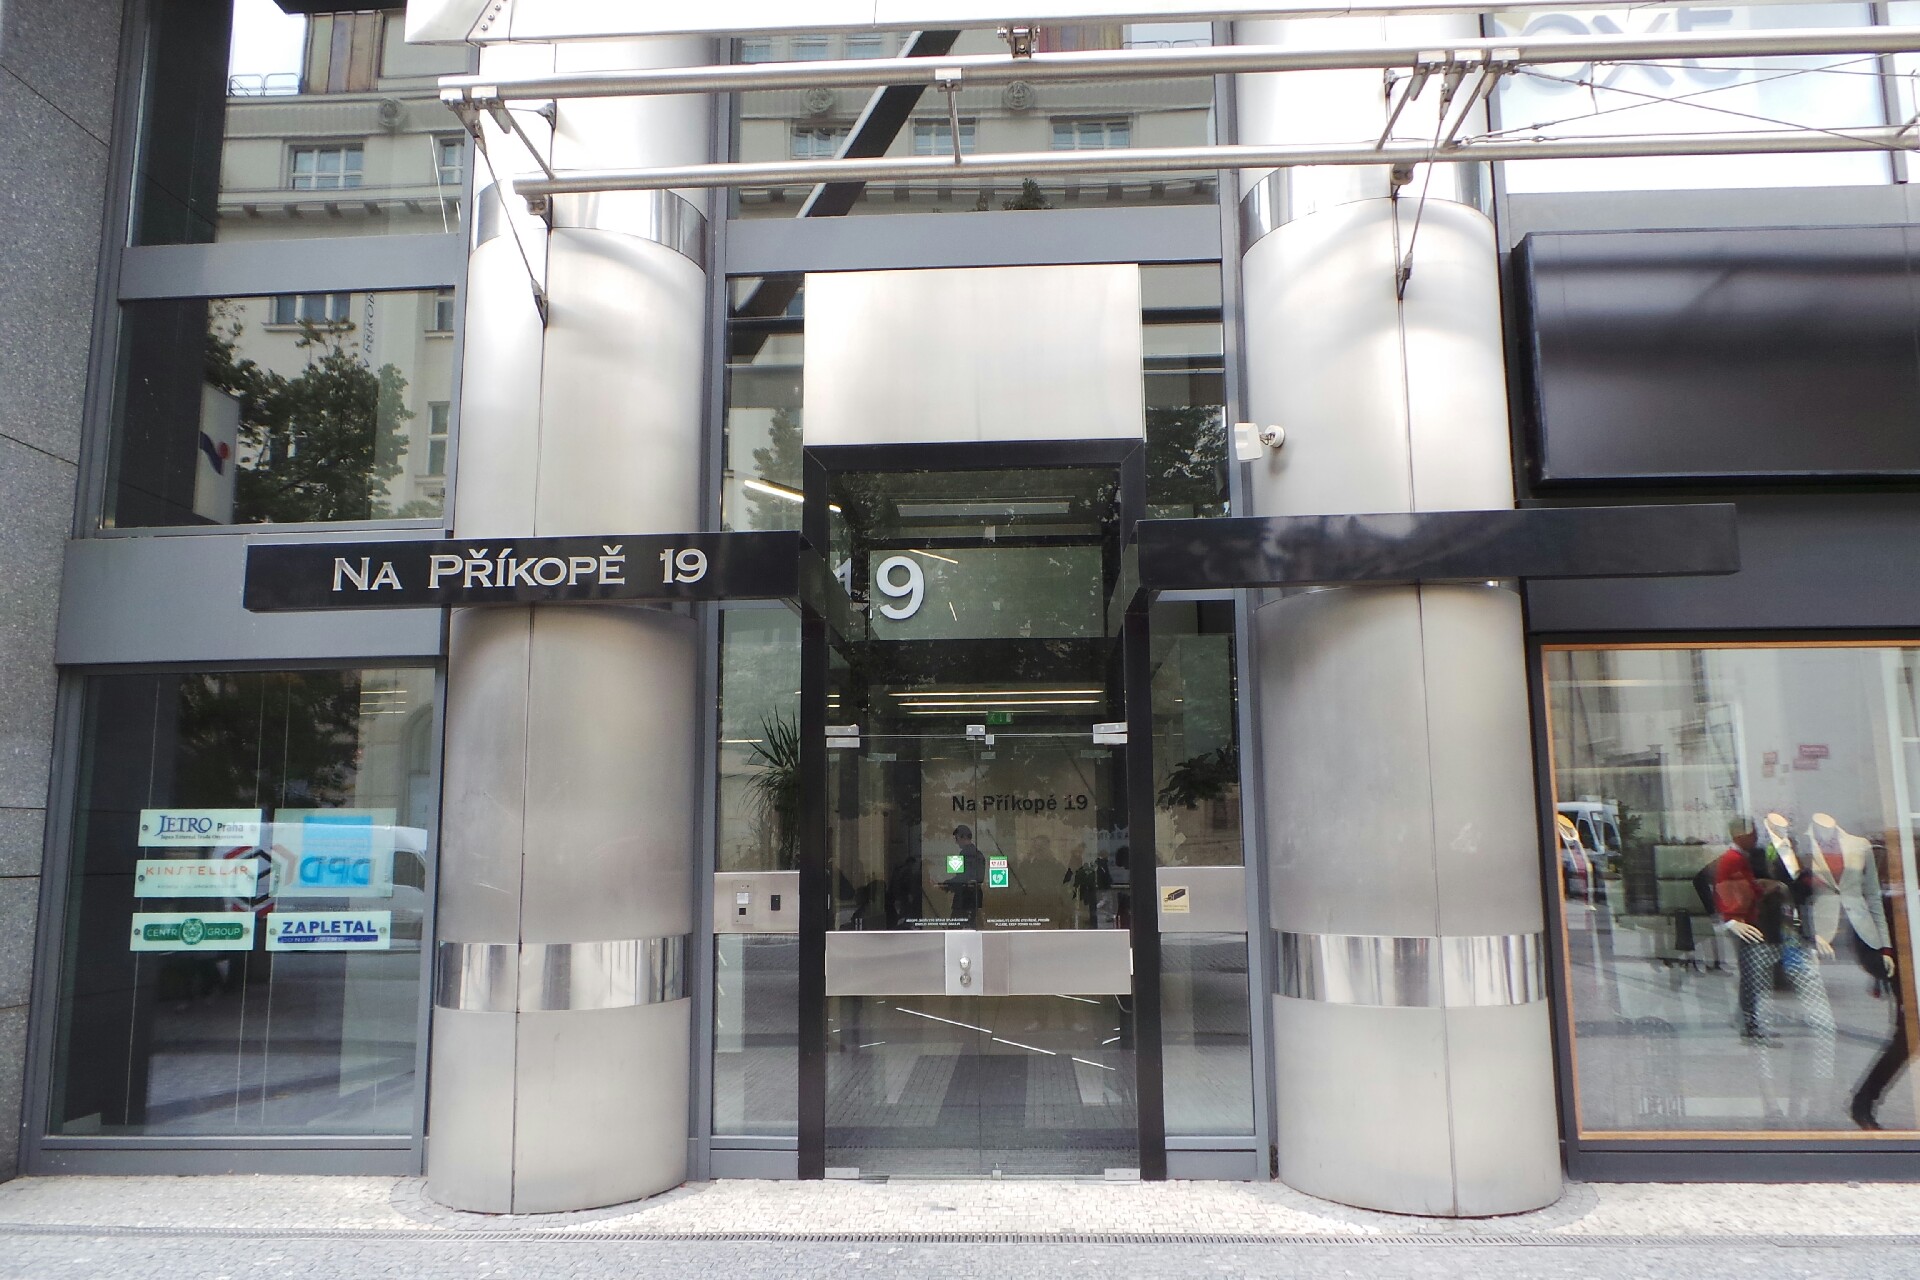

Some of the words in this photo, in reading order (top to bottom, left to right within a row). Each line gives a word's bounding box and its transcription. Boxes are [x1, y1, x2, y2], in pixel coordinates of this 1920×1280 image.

[428, 544, 627, 589] PŘÍKOPĚ
[660, 548, 708, 584] 19
[952, 795, 976, 811] Na
[1064, 794, 1088, 811] 19
[154, 815, 212, 837] JETRO
[217, 822, 244, 832] Praha
[145, 865, 248, 876] KINSTELLAR
[147, 928, 178, 937] CENTR
[207, 927, 241, 937] GROUP
[282, 920, 376, 934] ZAPLETAL
